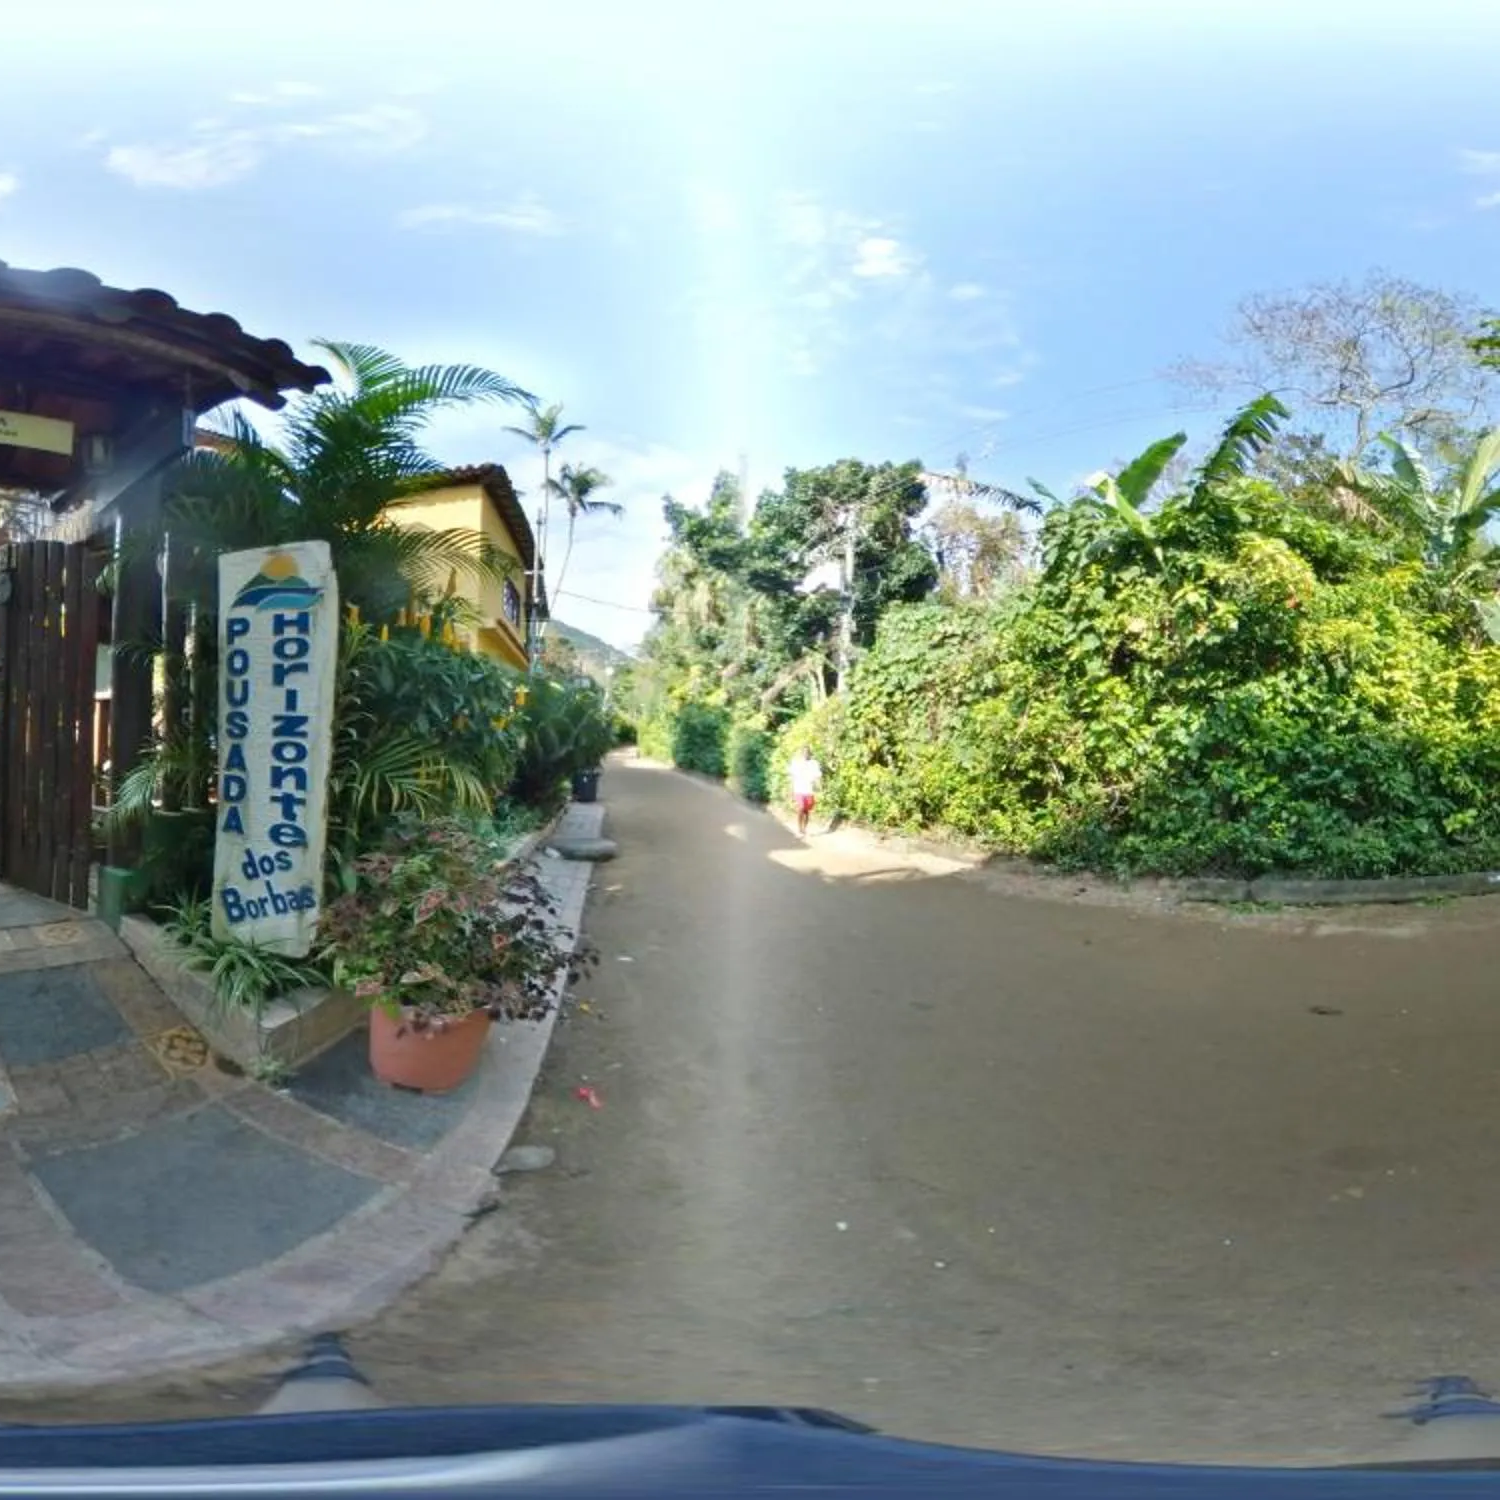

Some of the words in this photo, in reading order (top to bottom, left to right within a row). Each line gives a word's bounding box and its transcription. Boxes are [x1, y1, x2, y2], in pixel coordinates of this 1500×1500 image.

[223, 617, 250, 834] POUSADA
[241, 848, 293, 880] dos
[220, 881, 316, 925] Borbas
